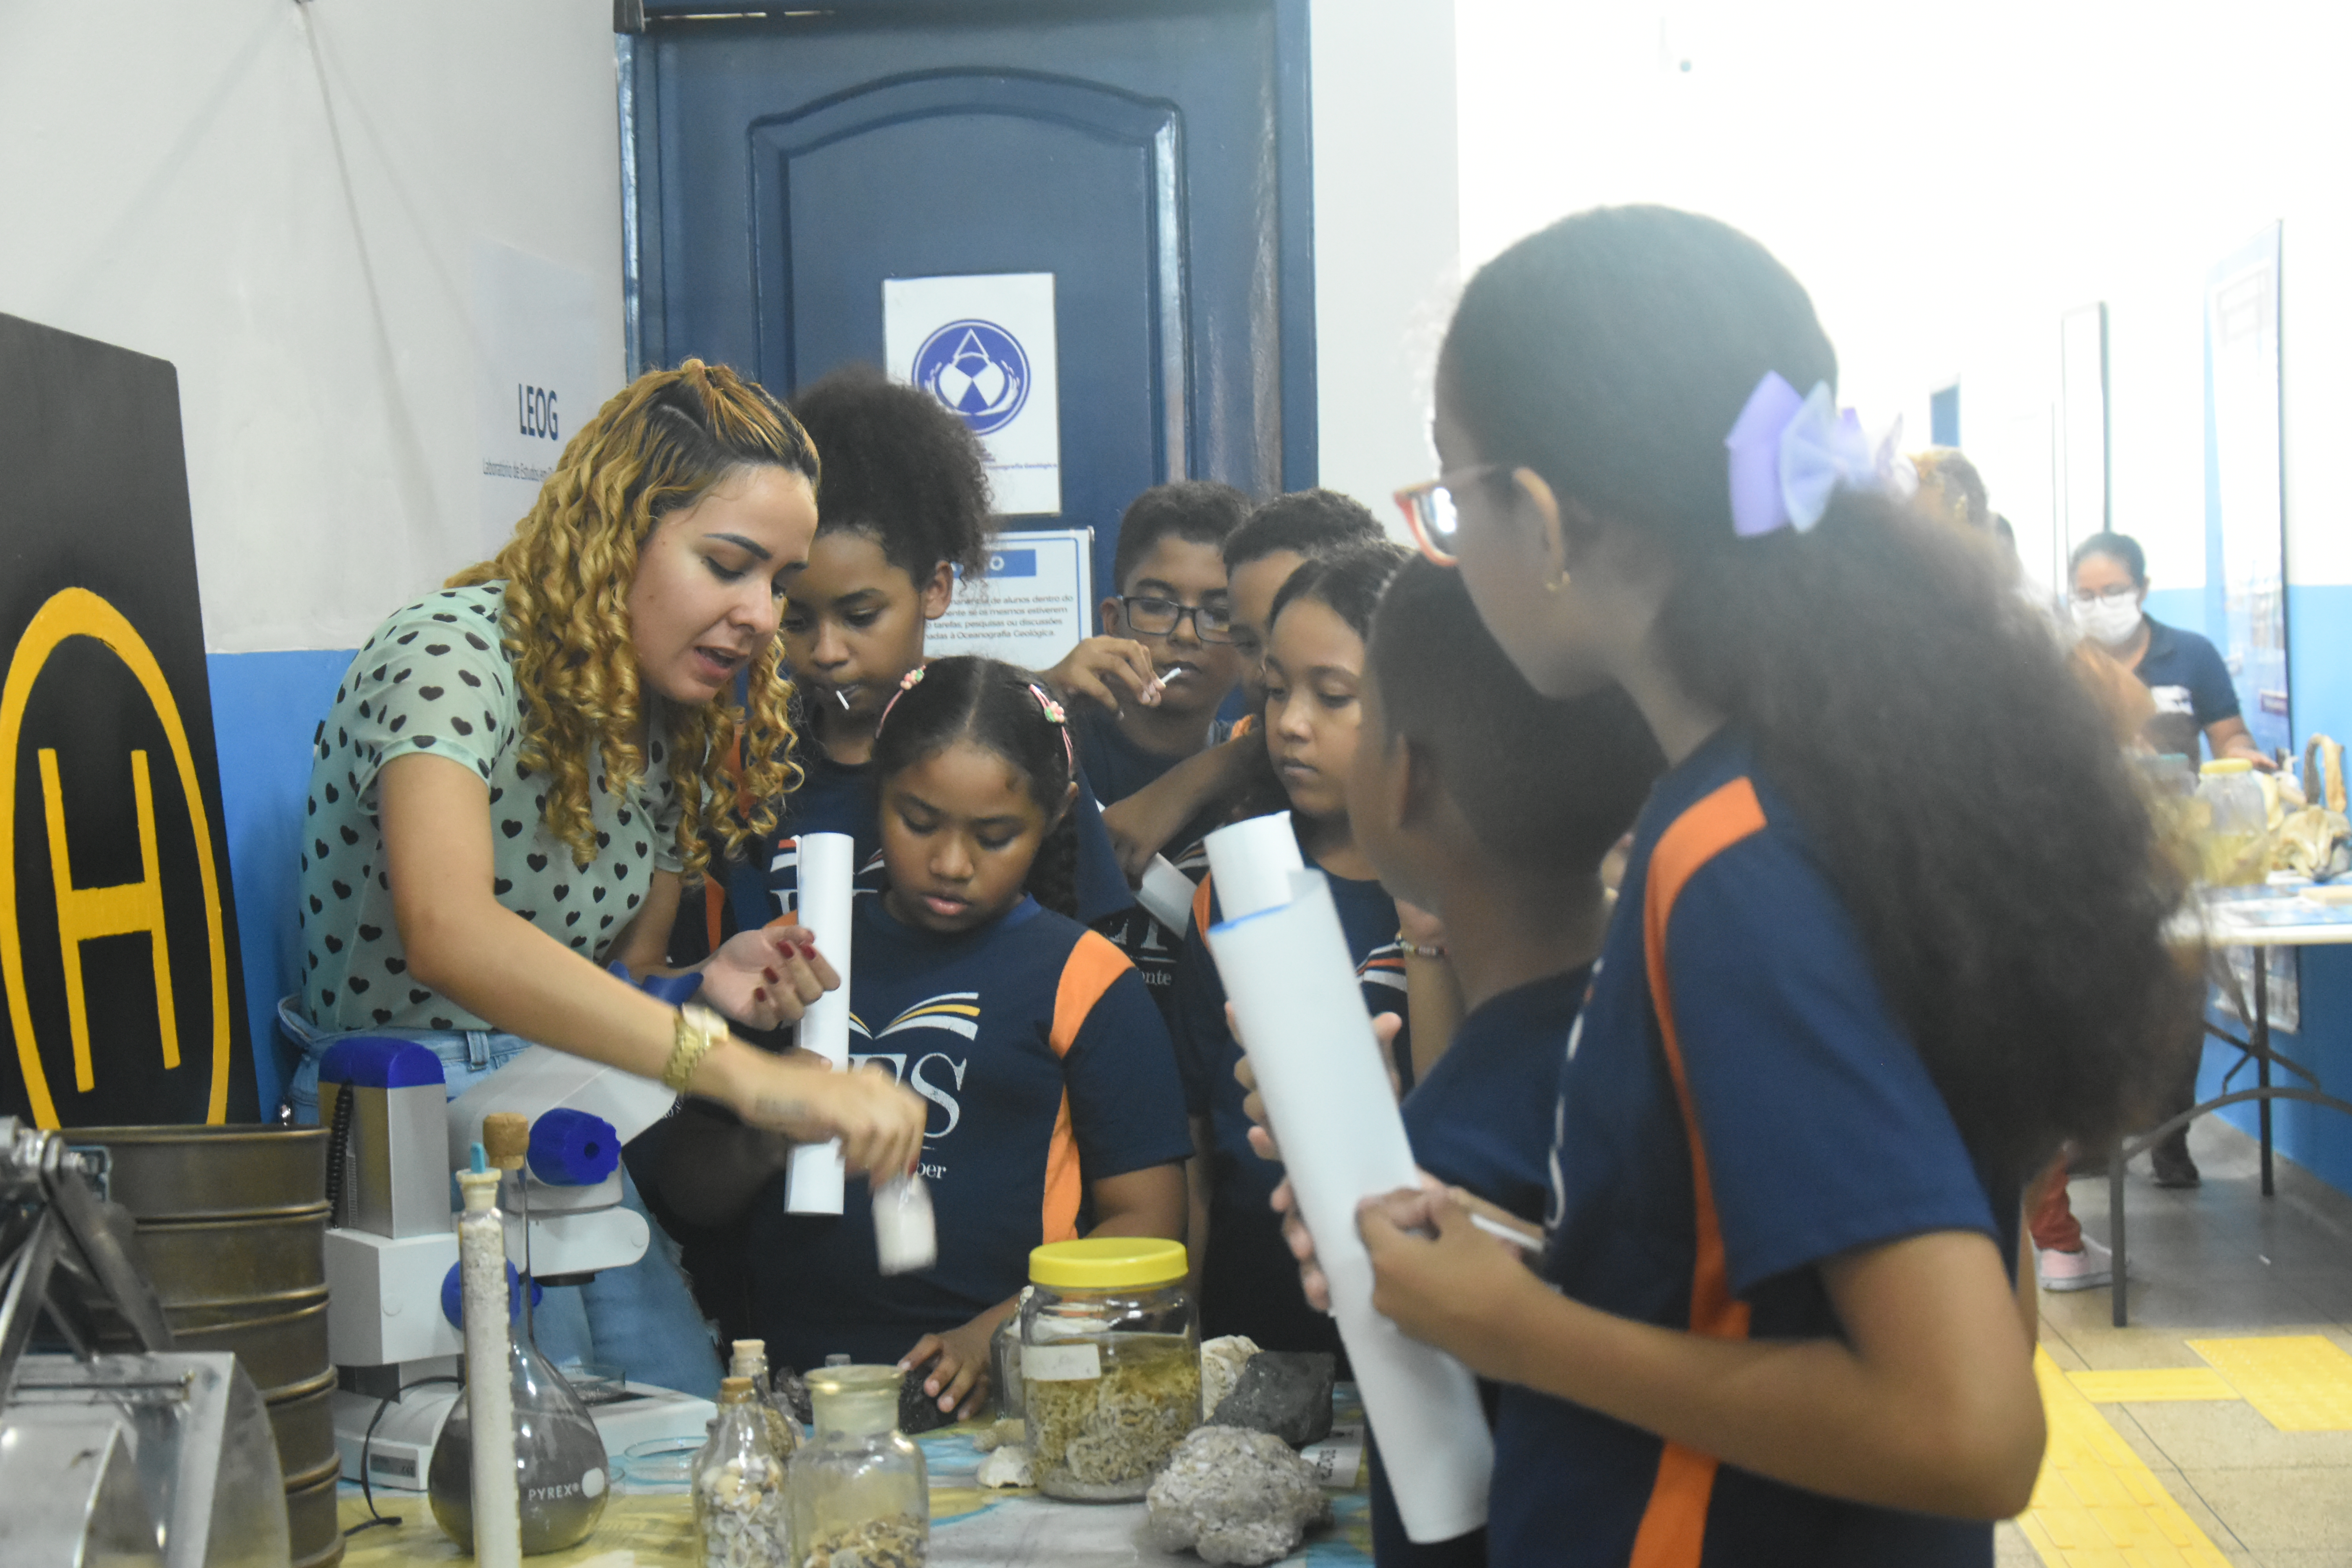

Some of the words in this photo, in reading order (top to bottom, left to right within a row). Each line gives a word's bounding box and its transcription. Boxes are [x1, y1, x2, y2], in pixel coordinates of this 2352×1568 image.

[519, 383, 558, 441] LEOG
[1003, 595, 1030, 604] alunos
[1032, 594, 1060, 603] dentro
[1062, 594, 1074, 602] do
[1027, 607, 1068, 615] estiverem
[965, 619, 1005, 629] pesquisas
[1019, 617, 1063, 626] discussões
[956, 629, 1011, 639] Oceanografia
